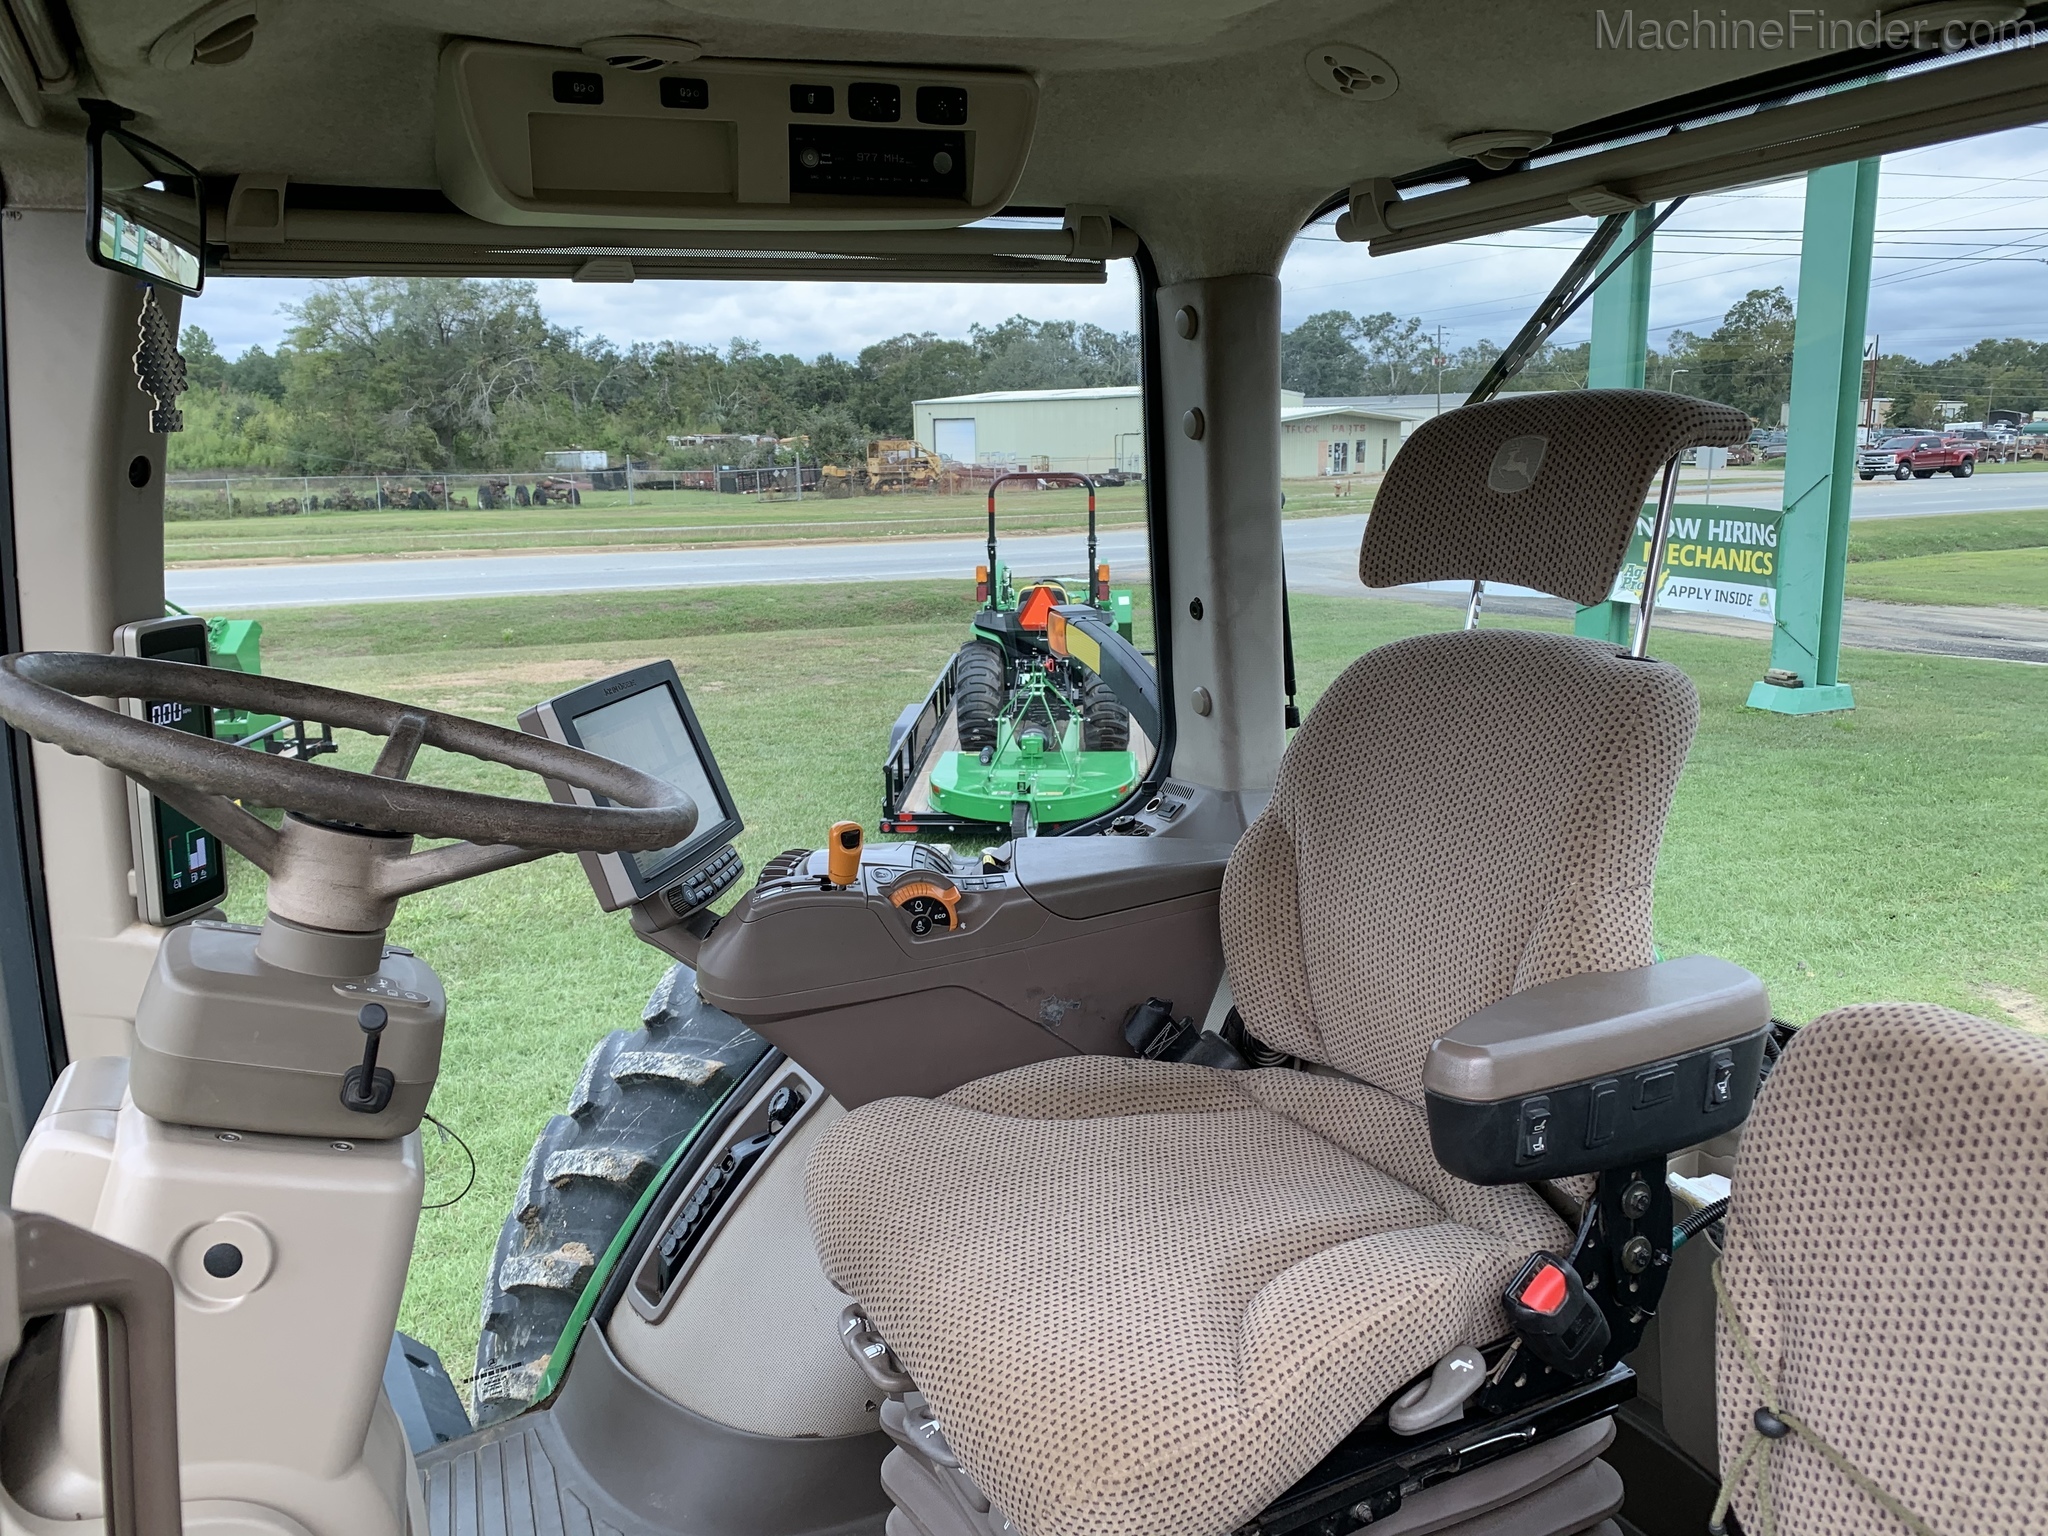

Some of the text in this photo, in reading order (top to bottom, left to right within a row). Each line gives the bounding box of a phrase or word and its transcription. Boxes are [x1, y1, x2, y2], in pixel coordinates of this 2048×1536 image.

[884, 153, 905, 164] MHz
[1708, 519, 1777, 548] HIRING
[1667, 585, 1753, 607] APPLY INSIDE
